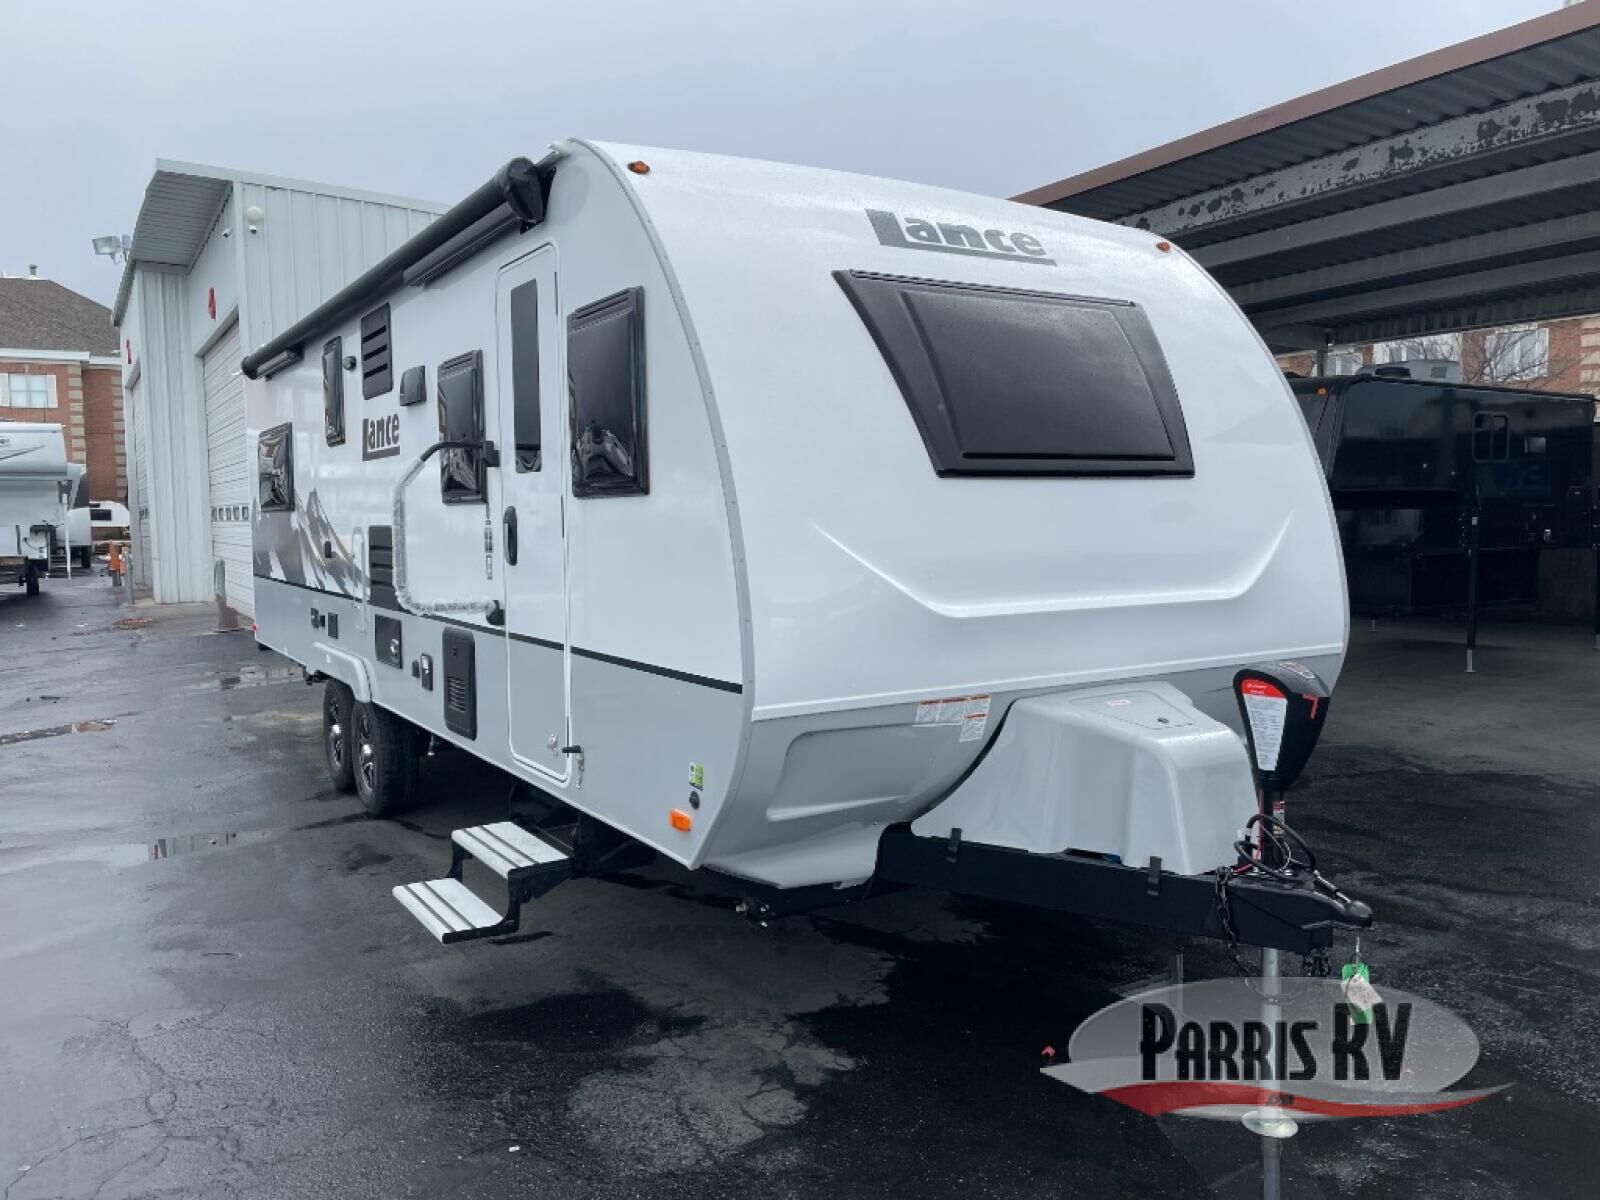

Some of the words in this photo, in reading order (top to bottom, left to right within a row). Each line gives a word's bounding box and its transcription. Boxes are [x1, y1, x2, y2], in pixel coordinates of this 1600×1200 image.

[864, 207, 1058, 267] Lance
[207, 287, 217, 321] 4
[362, 413, 401, 462] Lance
